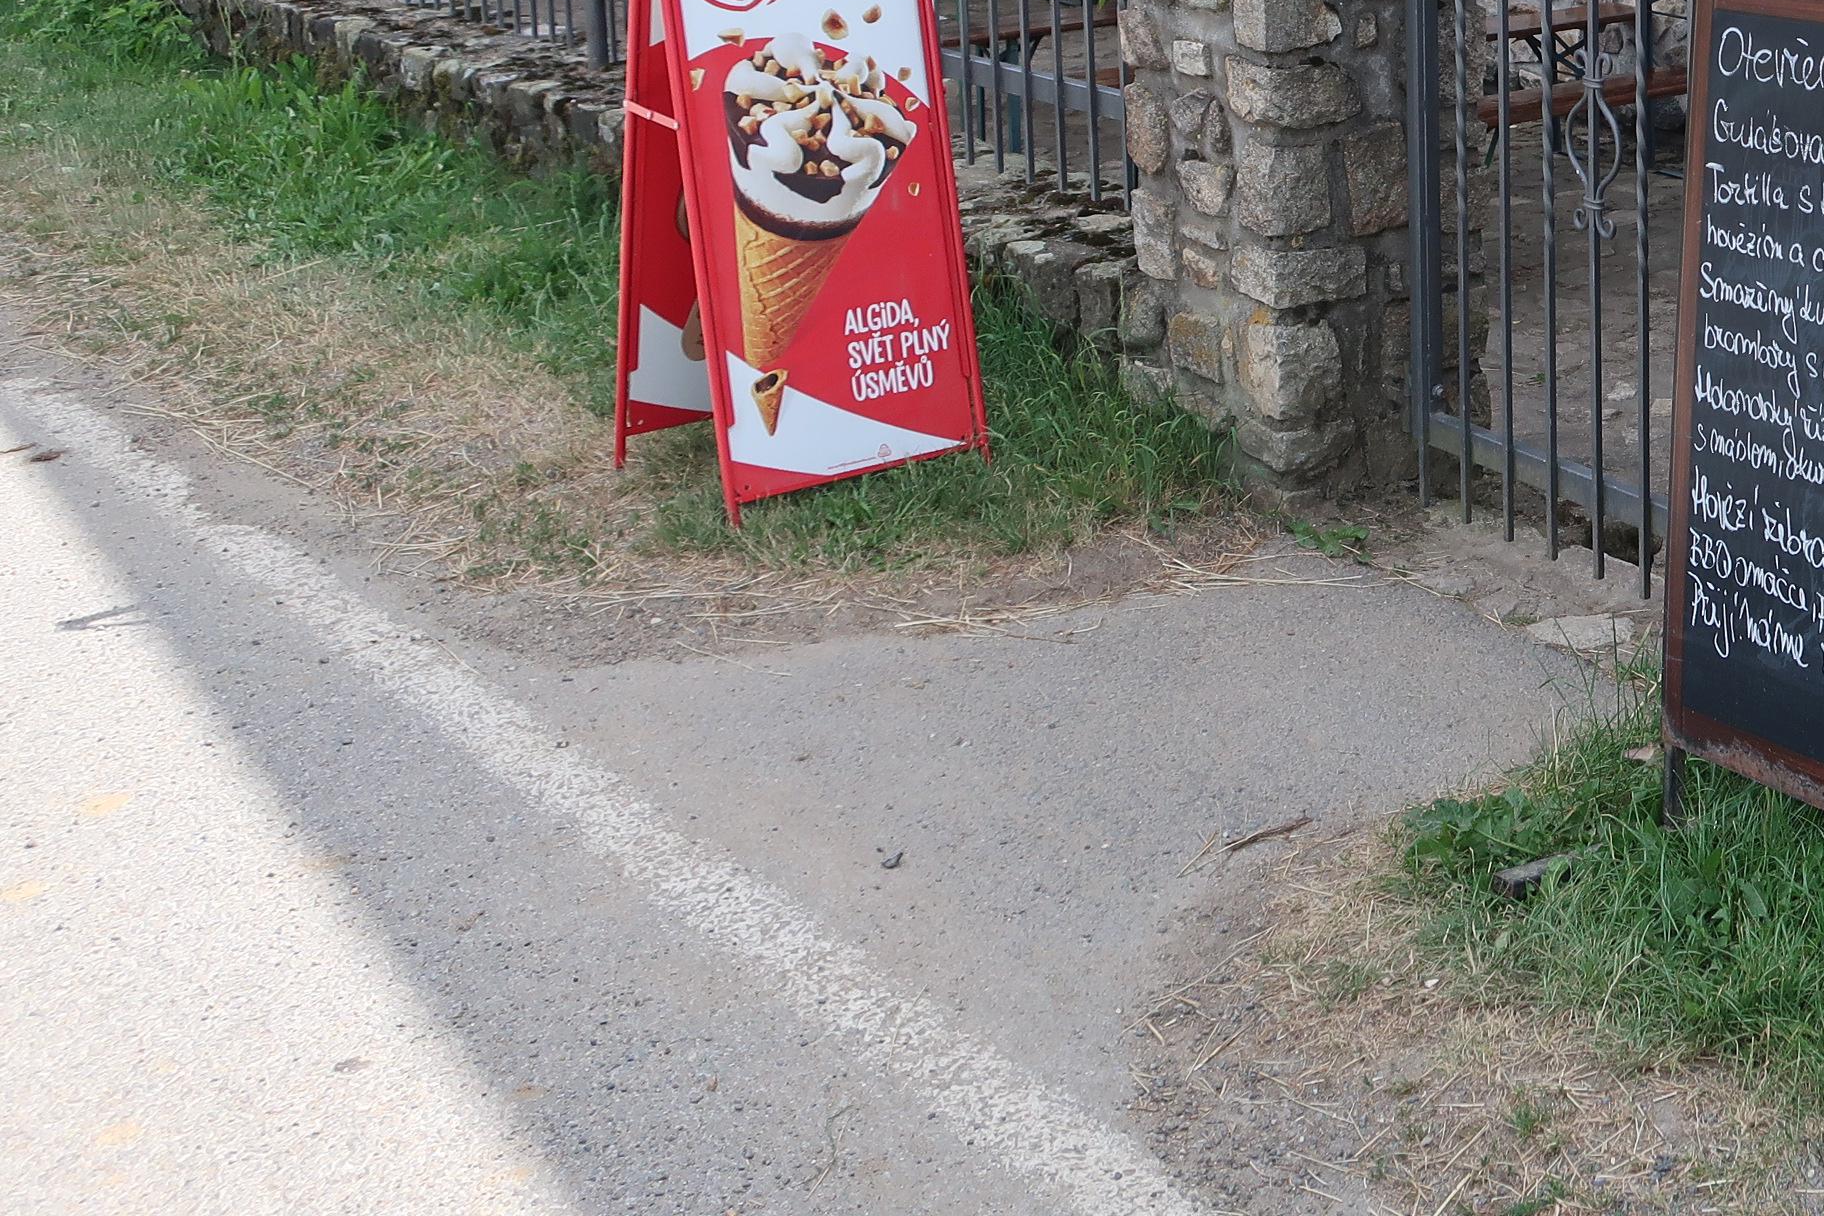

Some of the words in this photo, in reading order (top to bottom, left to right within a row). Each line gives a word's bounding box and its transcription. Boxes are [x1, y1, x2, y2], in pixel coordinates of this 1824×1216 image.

[1705, 161, 1789, 207] Tortilla
[1706, 214, 1783, 260] hovězím
[1789, 242, 1806, 267] a
[847, 331, 895, 370] SVĚT
[900, 318, 951, 359] PLNÝ
[851, 354, 934, 402] ÚSMĚVŮ
[1691, 464, 1760, 532] Hovězí
[1689, 527, 1733, 579] BBQ
